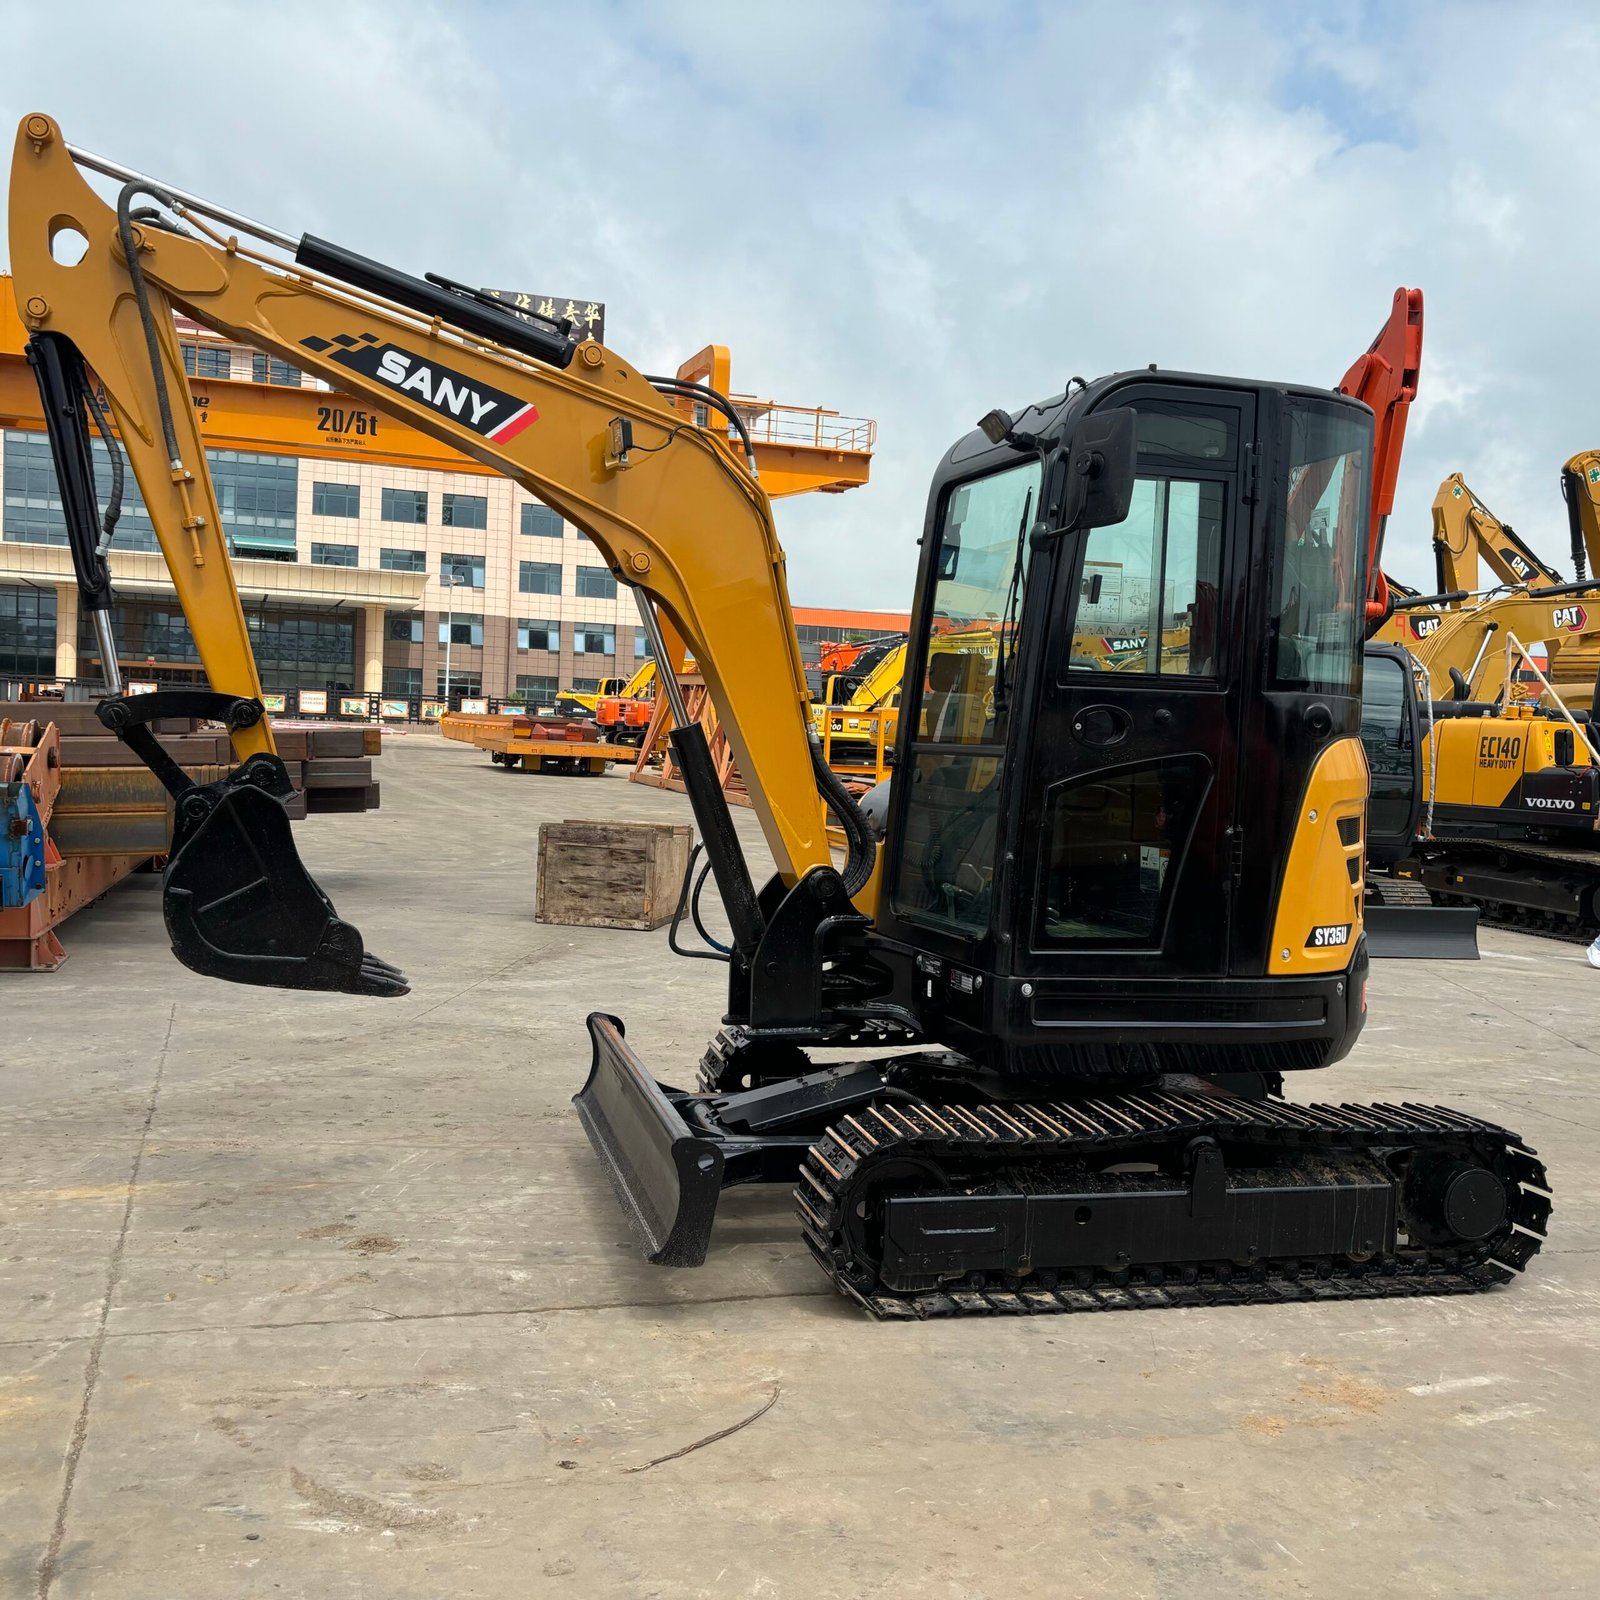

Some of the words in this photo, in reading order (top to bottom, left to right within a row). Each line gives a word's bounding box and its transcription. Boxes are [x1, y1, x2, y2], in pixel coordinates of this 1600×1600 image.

[376, 349, 498, 425] SANY
[317, 407, 379, 437] 20/5t
[1511, 556, 1530, 578] CAT
[1418, 617, 1441, 638] CAT
[1552, 606, 1579, 629] CAT
[1113, 638, 1146, 650] SANY
[1479, 736, 1521, 759] EC140
[1479, 758, 1498, 768] HEAVY
[1499, 760, 1517, 769] DUTY
[1525, 797, 1575, 810] VOLVO
[1315, 927, 1346, 945] SY35U
